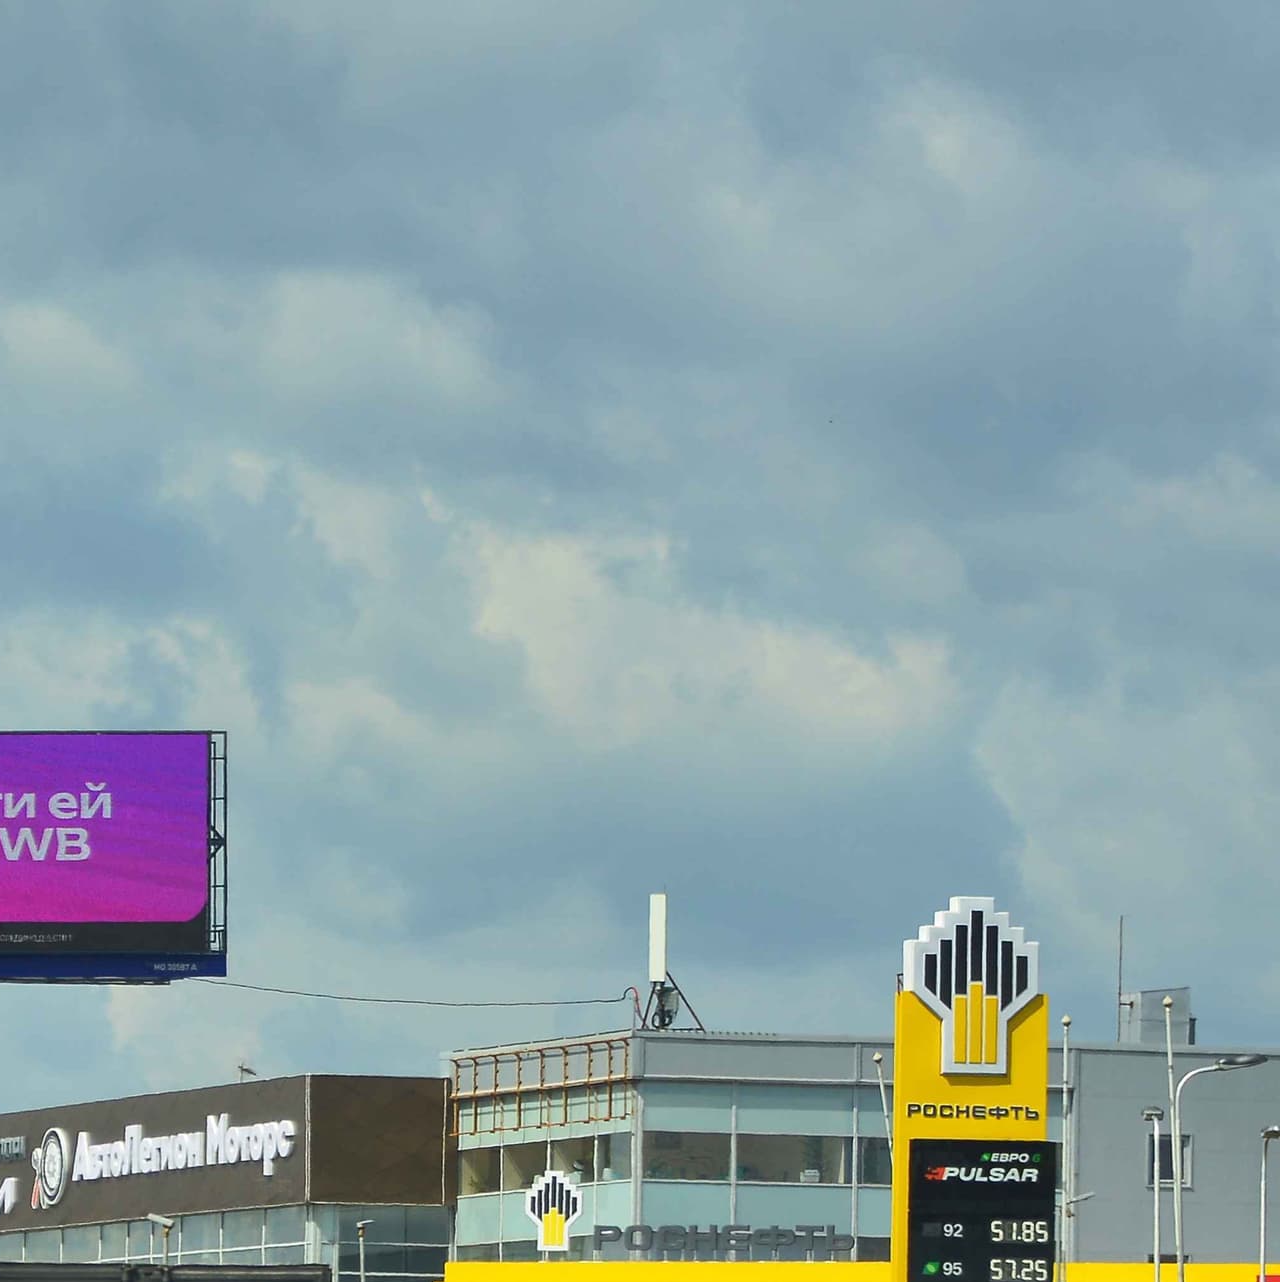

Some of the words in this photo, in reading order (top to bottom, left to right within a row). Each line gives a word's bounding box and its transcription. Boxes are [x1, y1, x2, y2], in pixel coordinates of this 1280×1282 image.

[48, 784, 112, 819] ей
[907, 1103, 1039, 1121] РОСНЕФТЬ
[206, 1112, 296, 1177] Моторс
[990, 1153, 1030, 1163] ЕВРО
[942, 1167, 1039, 1182] PULSAR
[593, 1224, 855, 1252] РОСНЕФТЬ
[943, 1224, 963, 1238] 92
[990, 1220, 1048, 1242] 51.85
[942, 1262, 962, 1276] 95
[990, 1259, 1047, 1281] 57.25
